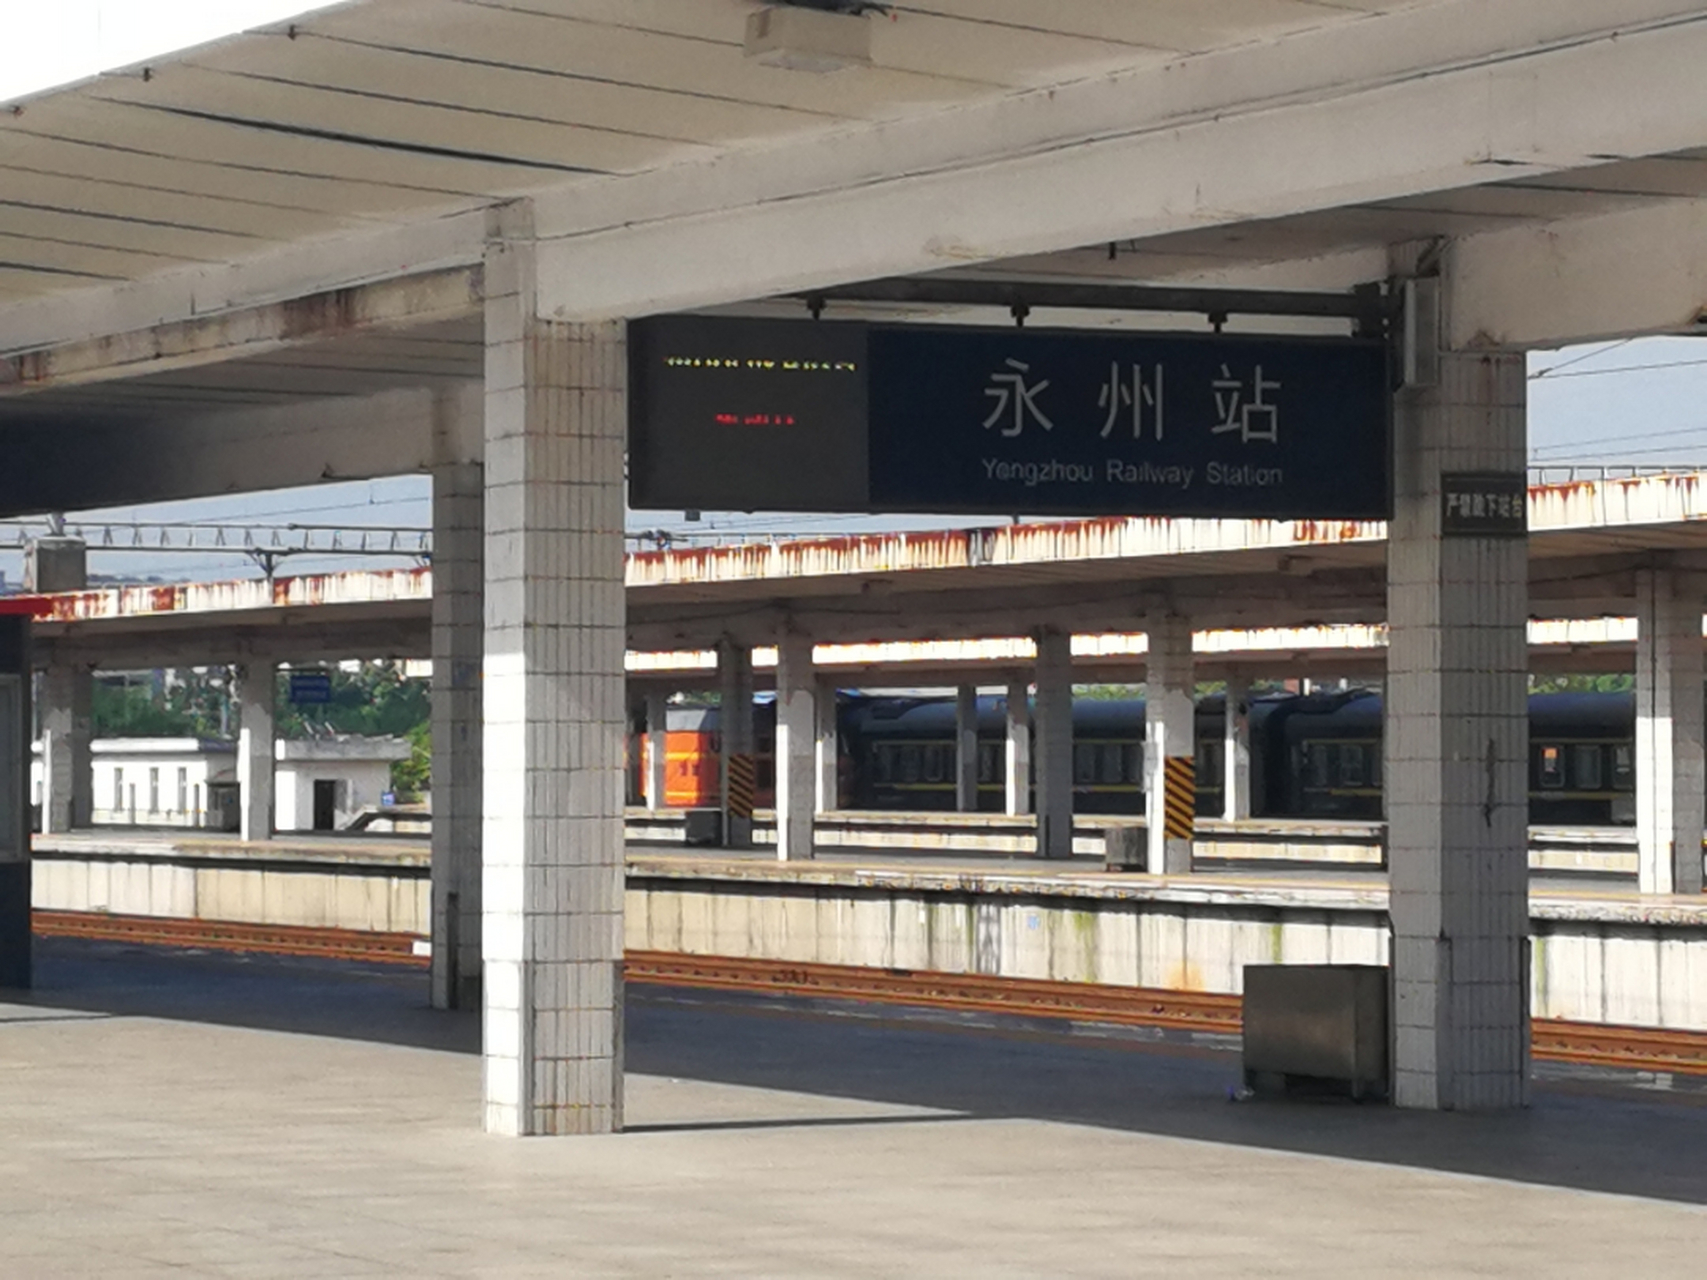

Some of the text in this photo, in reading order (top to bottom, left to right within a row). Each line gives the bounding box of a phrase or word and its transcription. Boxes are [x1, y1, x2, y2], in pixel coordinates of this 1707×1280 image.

[982, 357, 1282, 443] 永州站
[1106, 459, 1195, 489] Railway
[1206, 461, 1283, 486] Station
